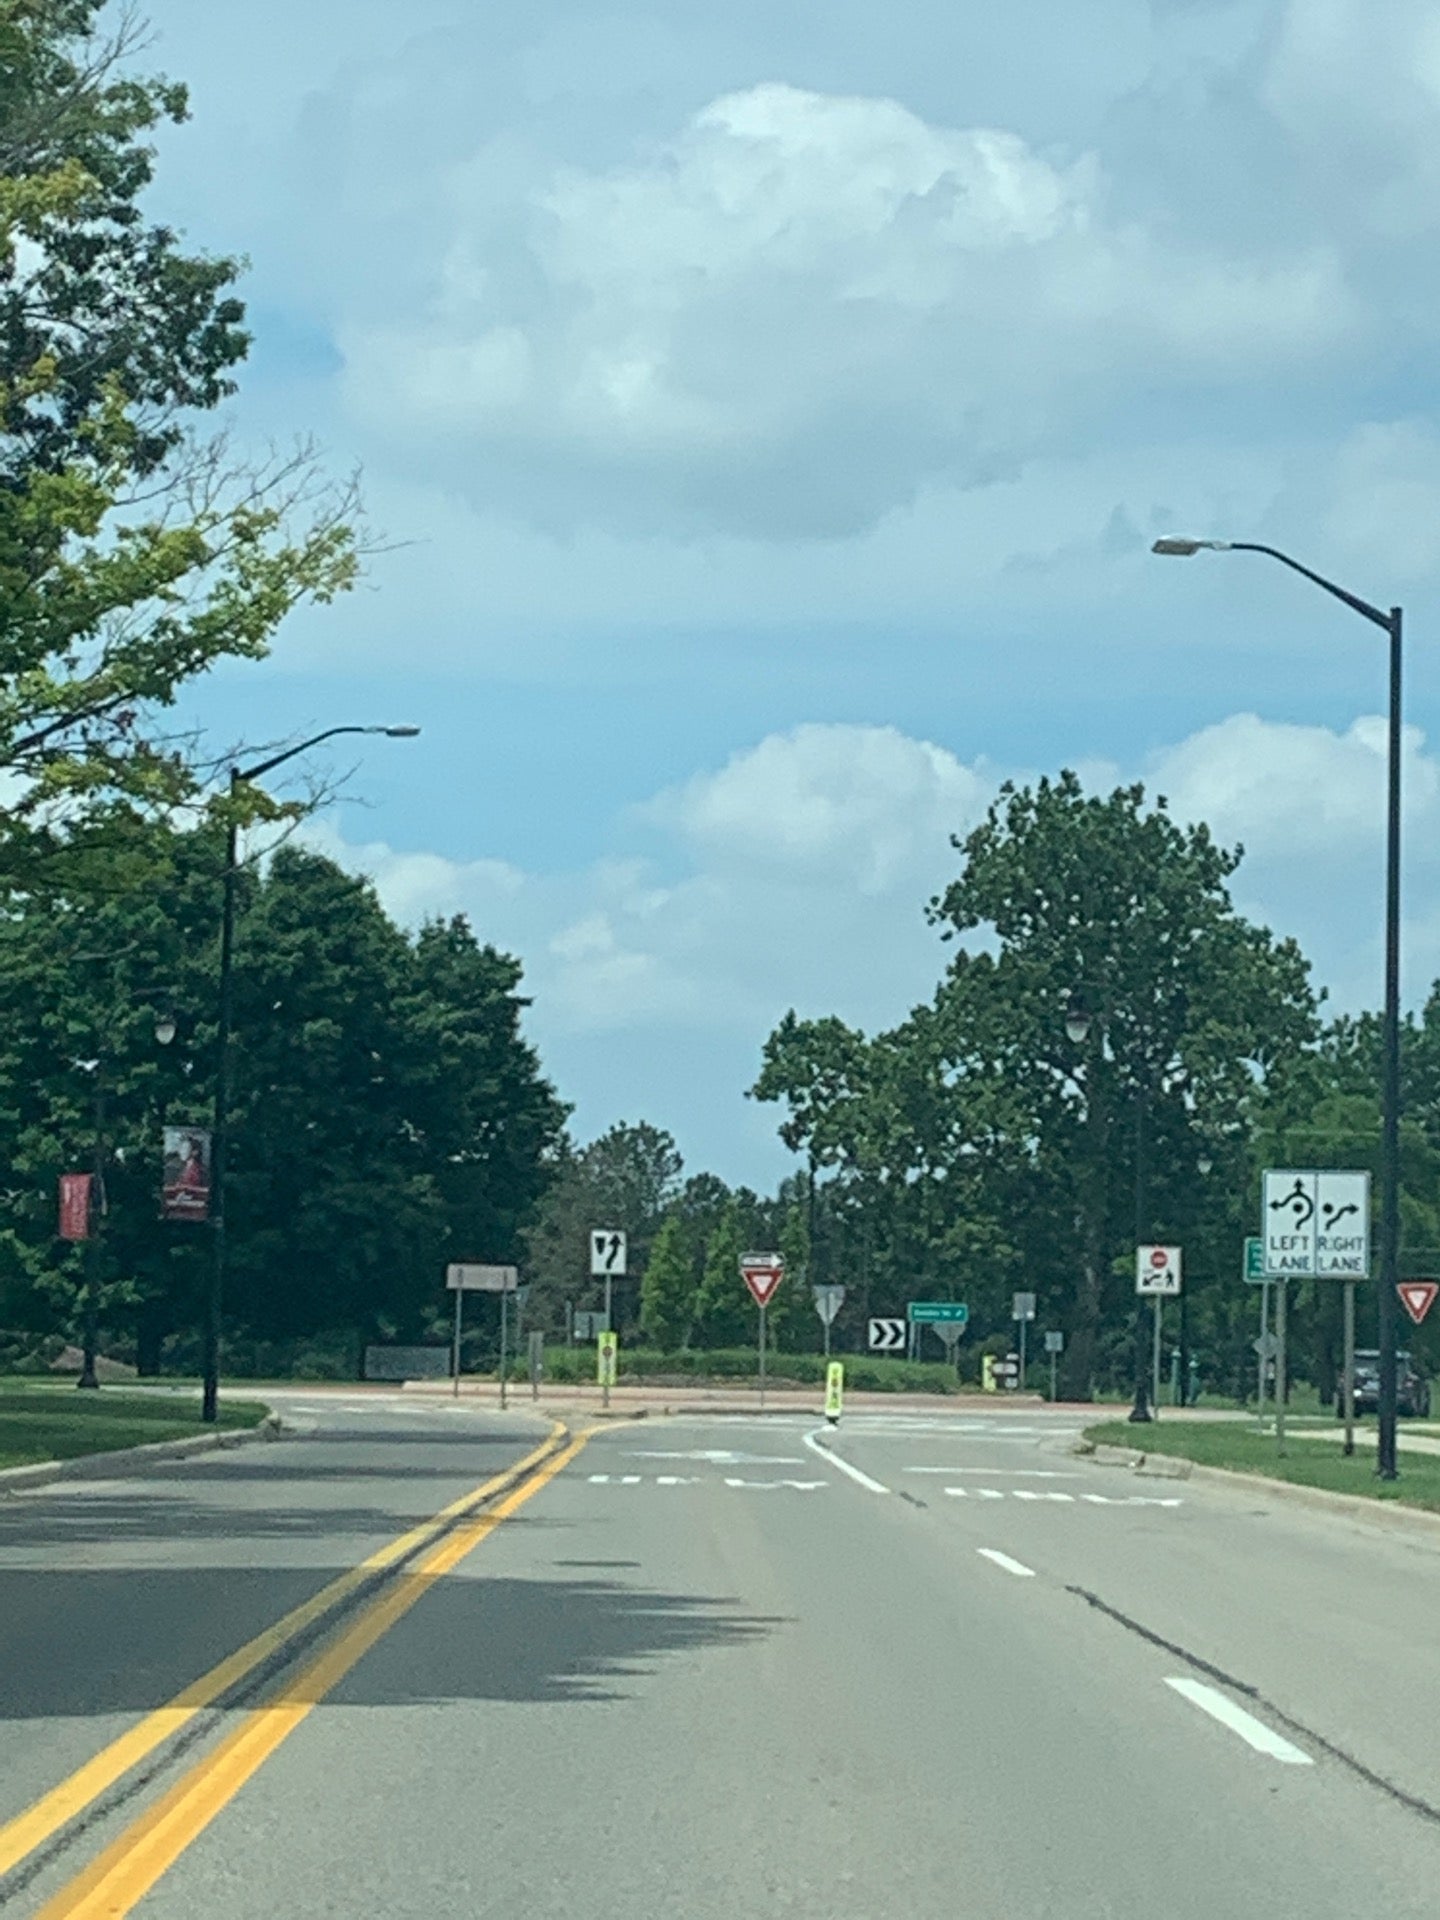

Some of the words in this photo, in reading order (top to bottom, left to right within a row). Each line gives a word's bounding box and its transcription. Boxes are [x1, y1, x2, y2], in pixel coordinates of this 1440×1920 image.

[1270, 1235, 1310, 1251] LEFT
[1268, 1255, 1311, 1271] LANE
[1318, 1256, 1362, 1272] LANE
